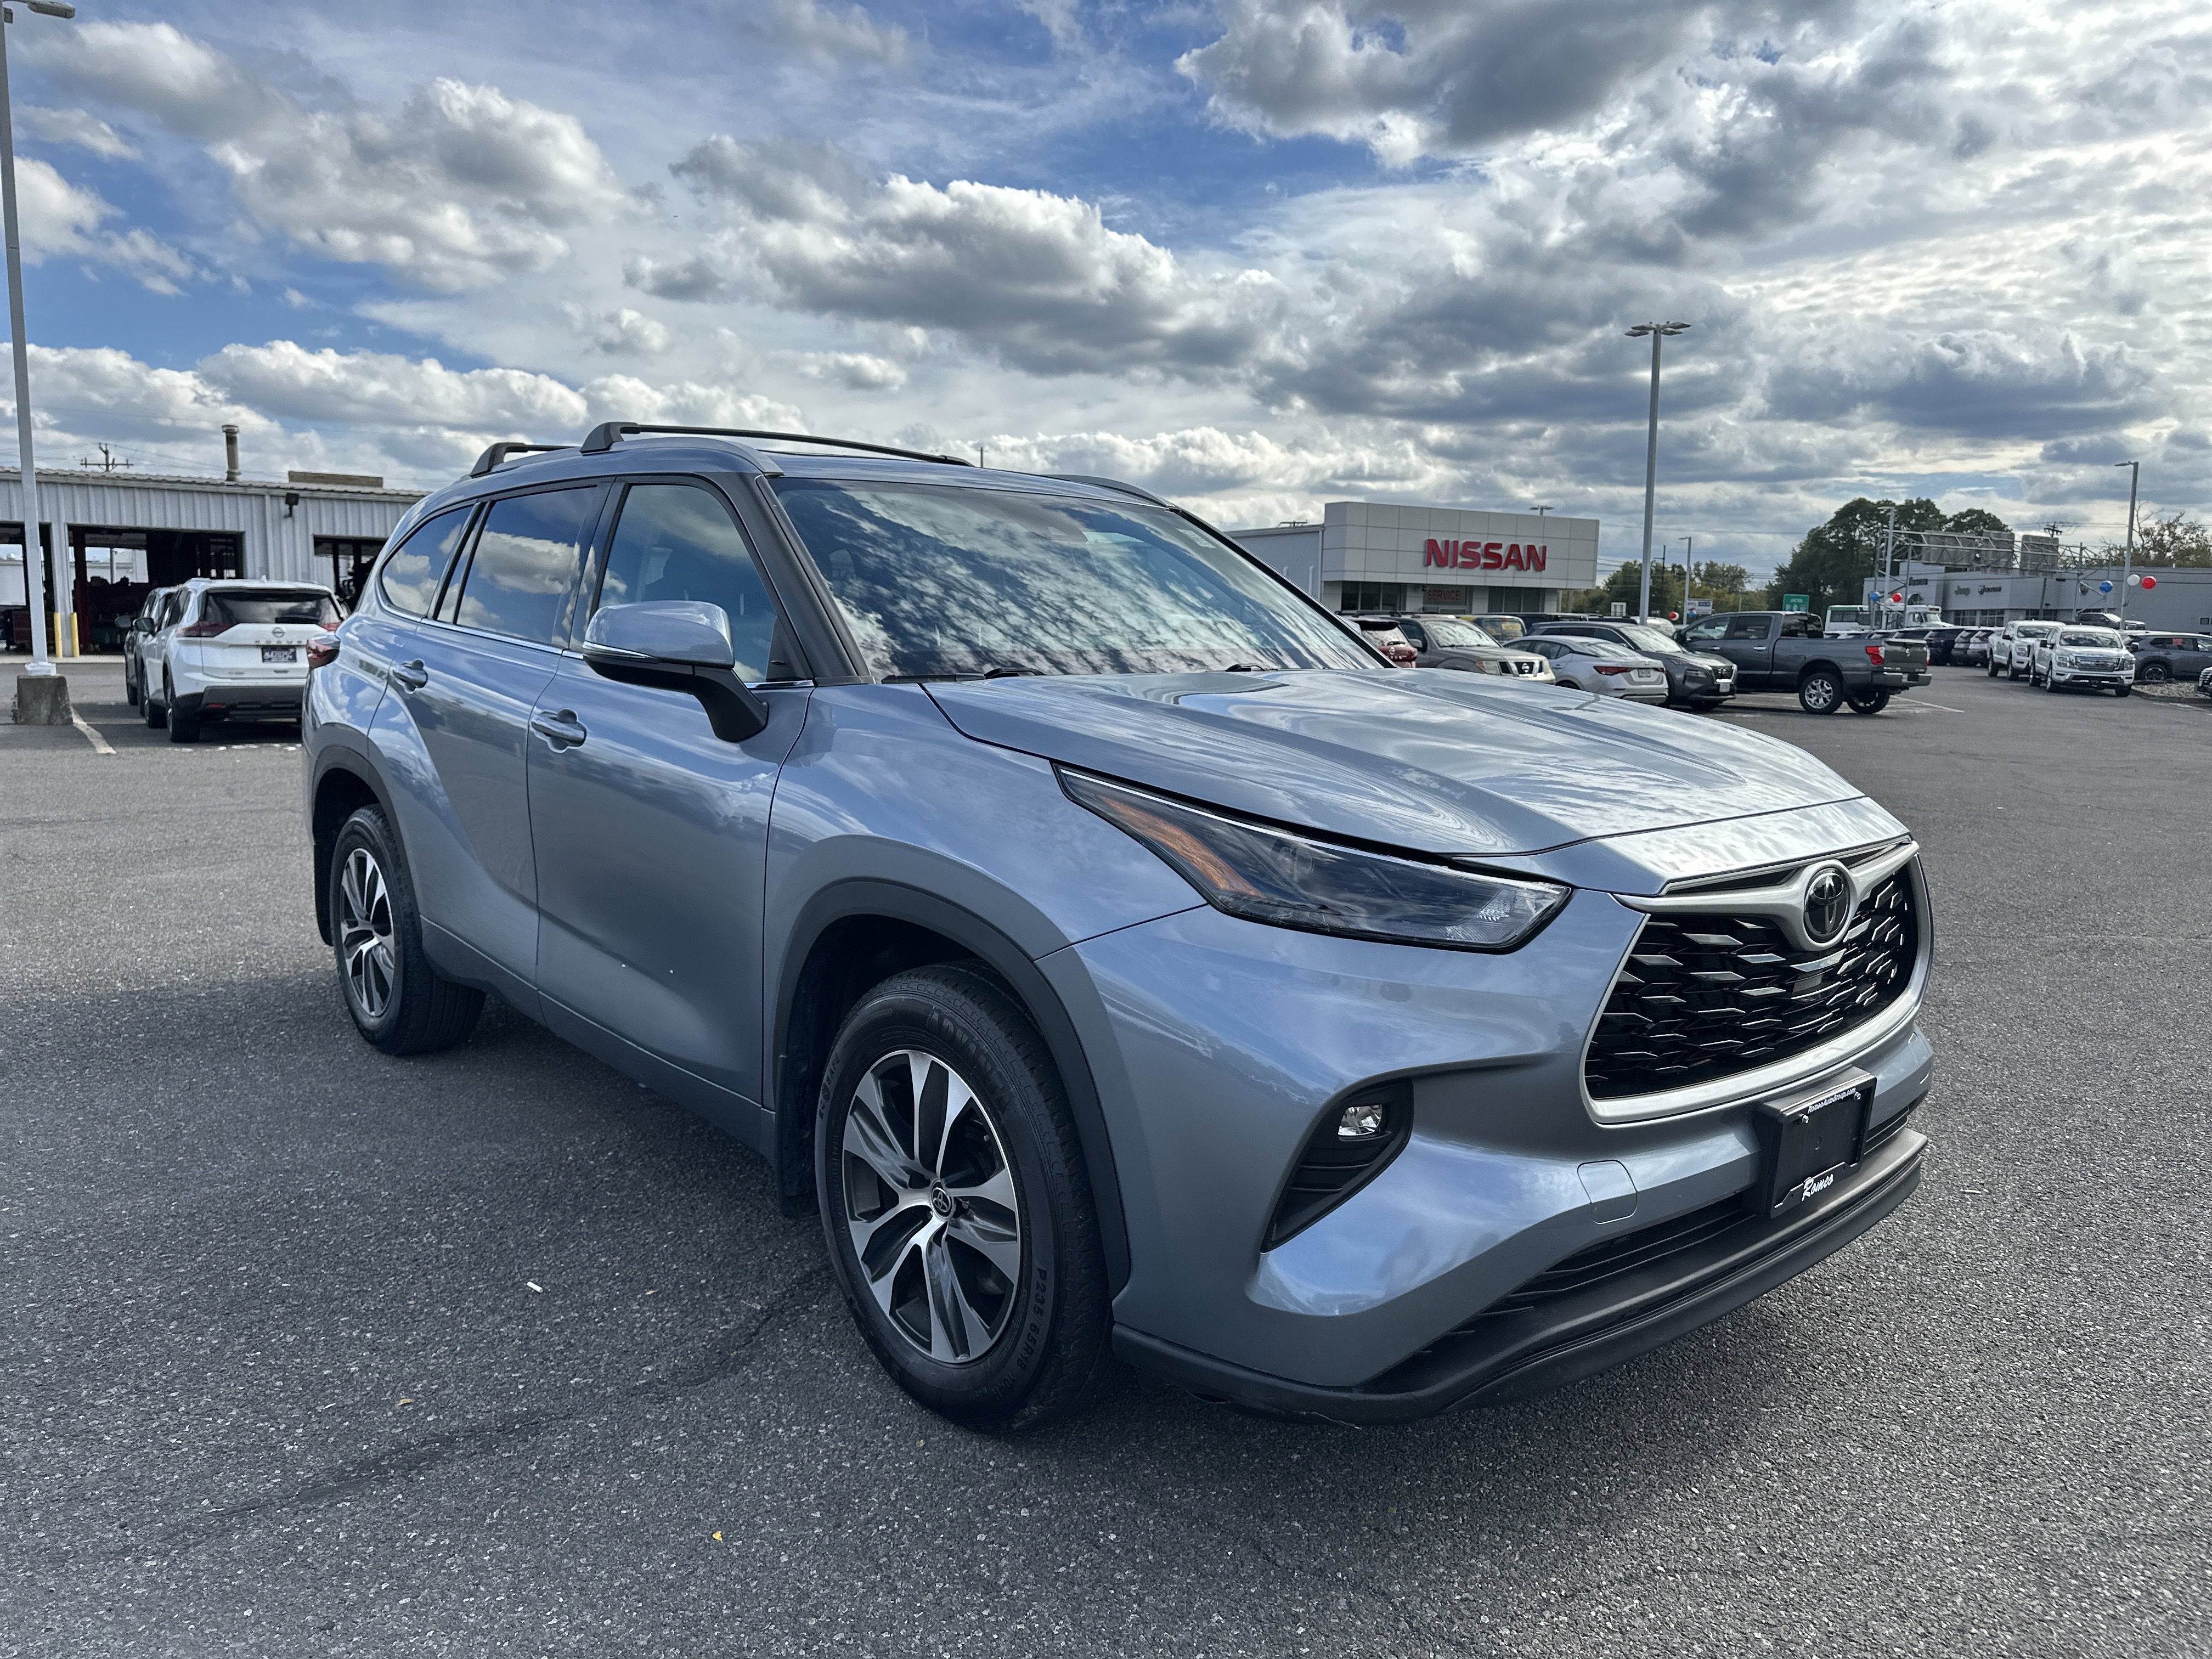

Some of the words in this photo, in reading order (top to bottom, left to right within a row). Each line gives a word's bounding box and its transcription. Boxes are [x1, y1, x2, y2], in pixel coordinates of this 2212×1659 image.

[1425, 539, 1547, 571] NISSAN
[1427, 589, 1460, 601] SERVICE
[1801, 1174, 1833, 1201] Romeo
[1017, 1267, 1047, 1370] P235/65R18
